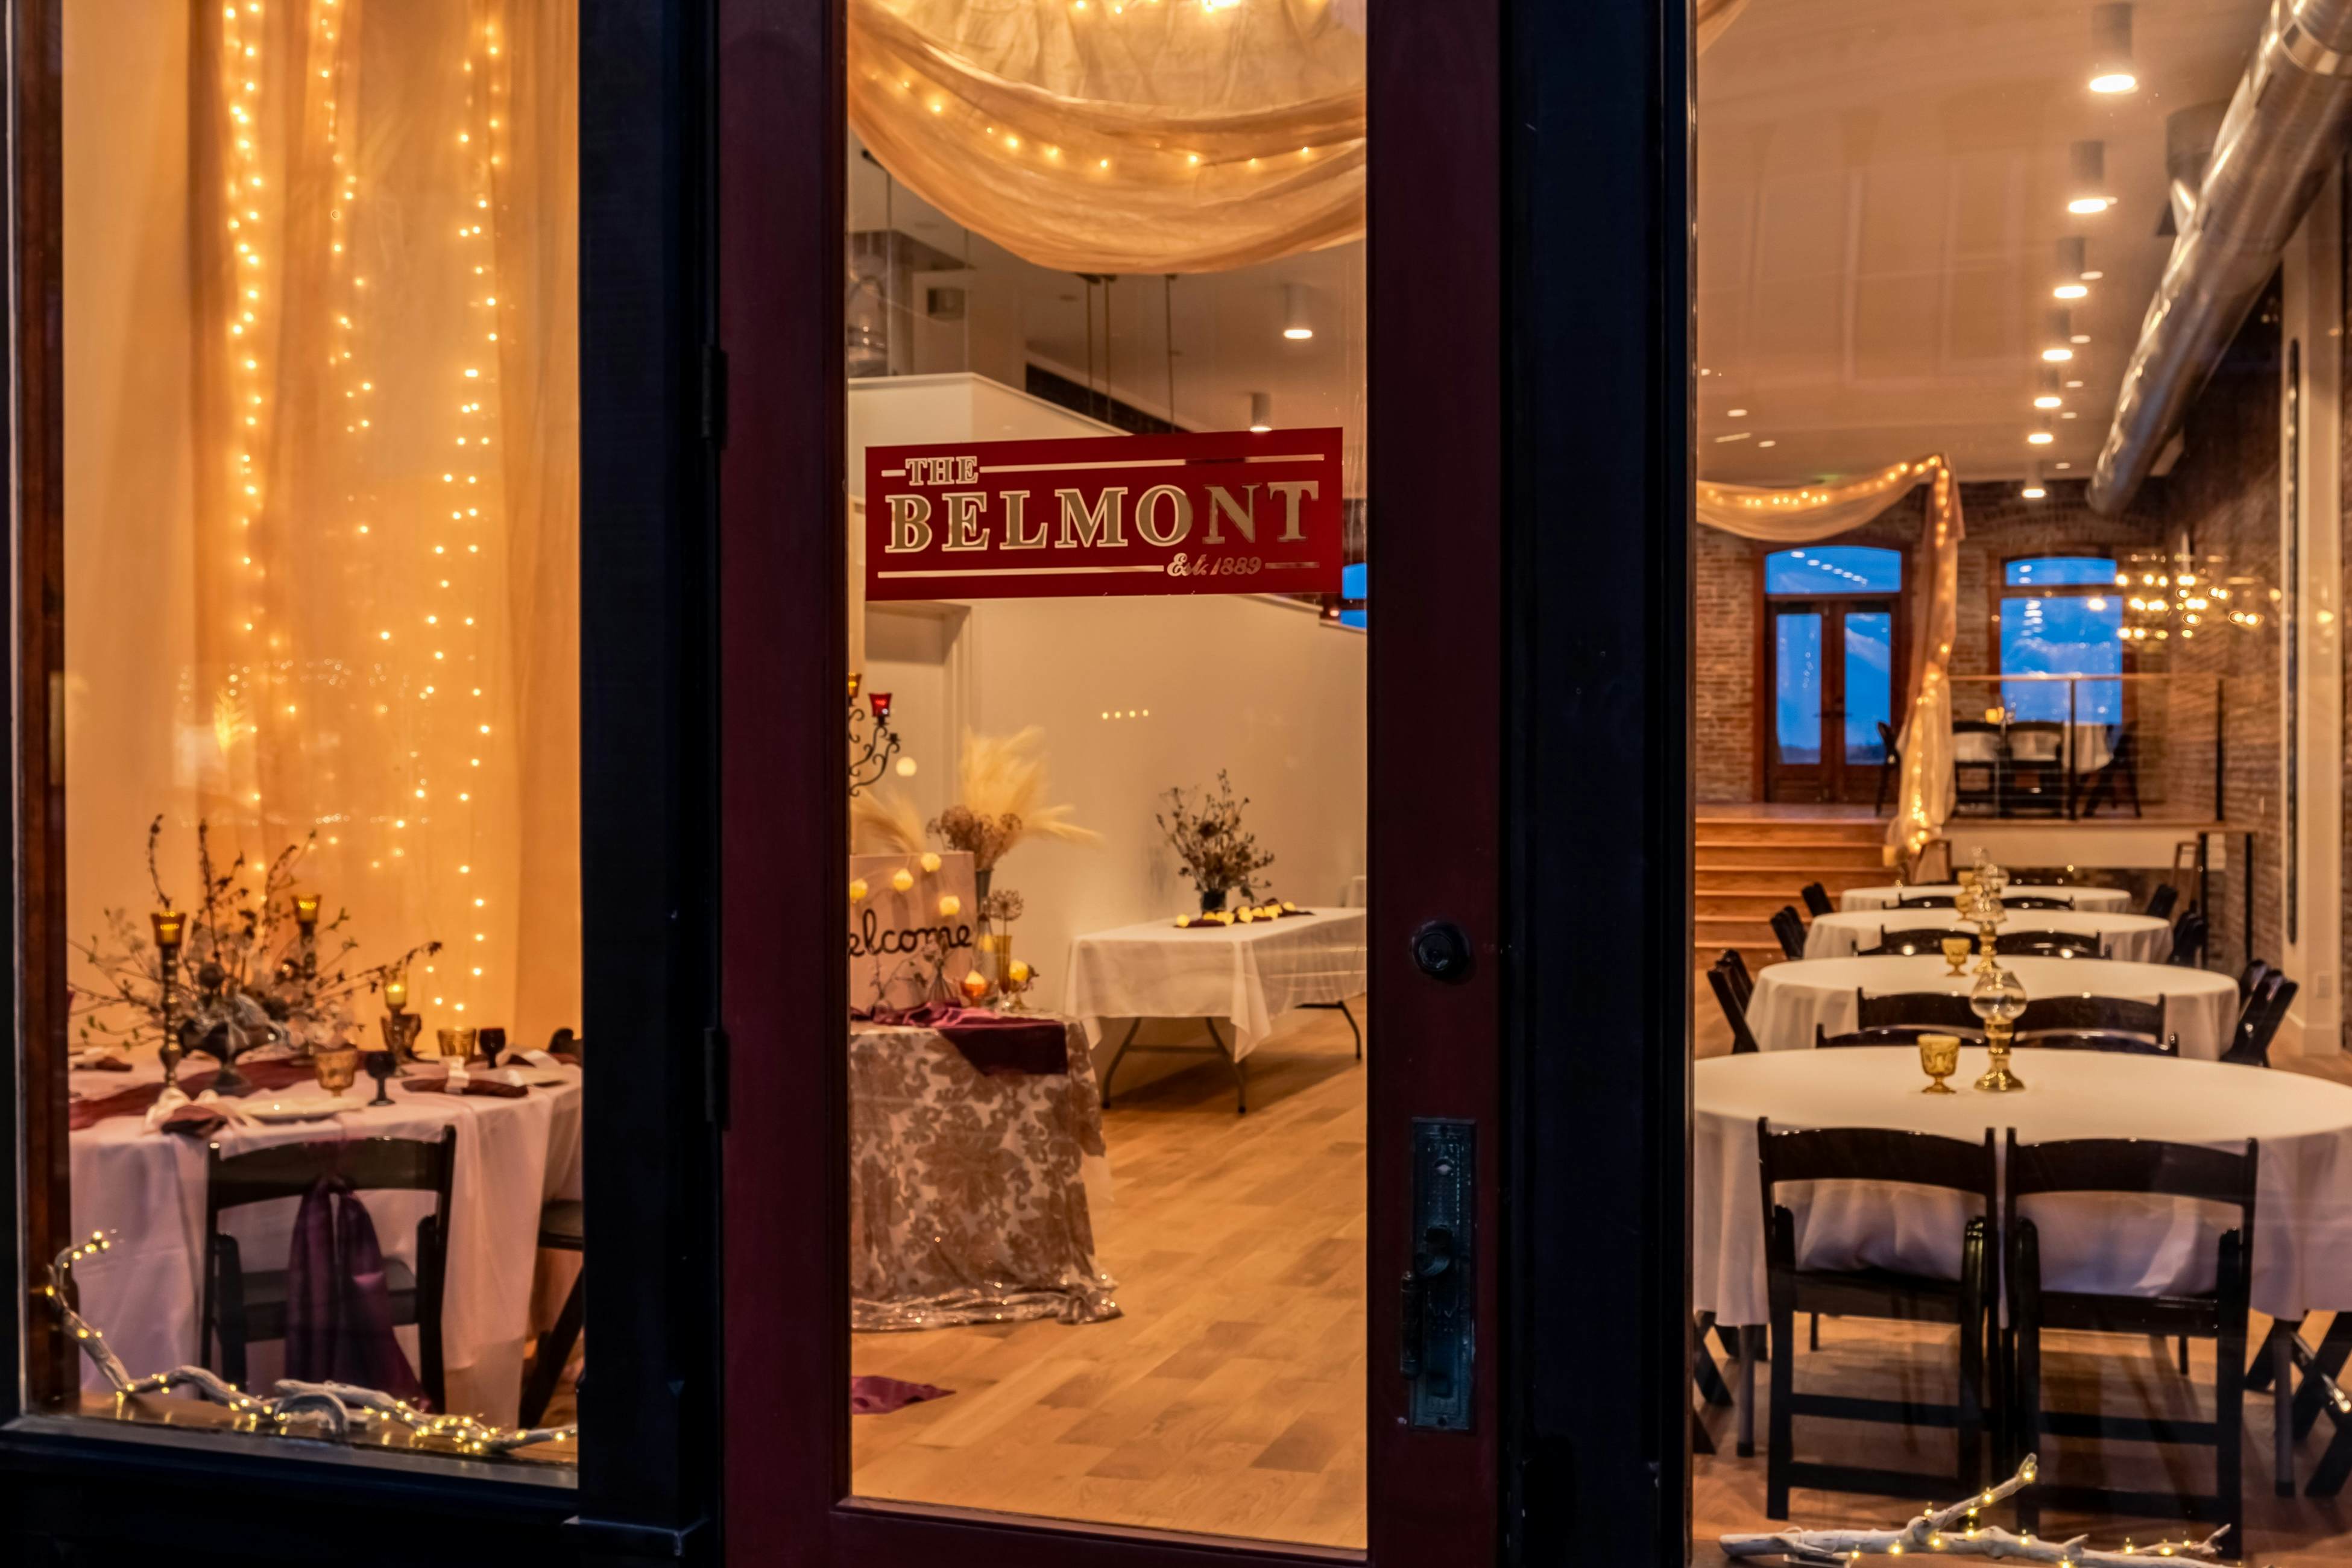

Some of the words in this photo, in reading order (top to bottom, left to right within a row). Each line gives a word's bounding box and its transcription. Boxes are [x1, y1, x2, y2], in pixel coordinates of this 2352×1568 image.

[905, 456, 979, 485] THE
[884, 480, 1319, 553] BELMONT
[1209, 556, 1262, 576] 1889
[850, 908, 973, 957] elcome
